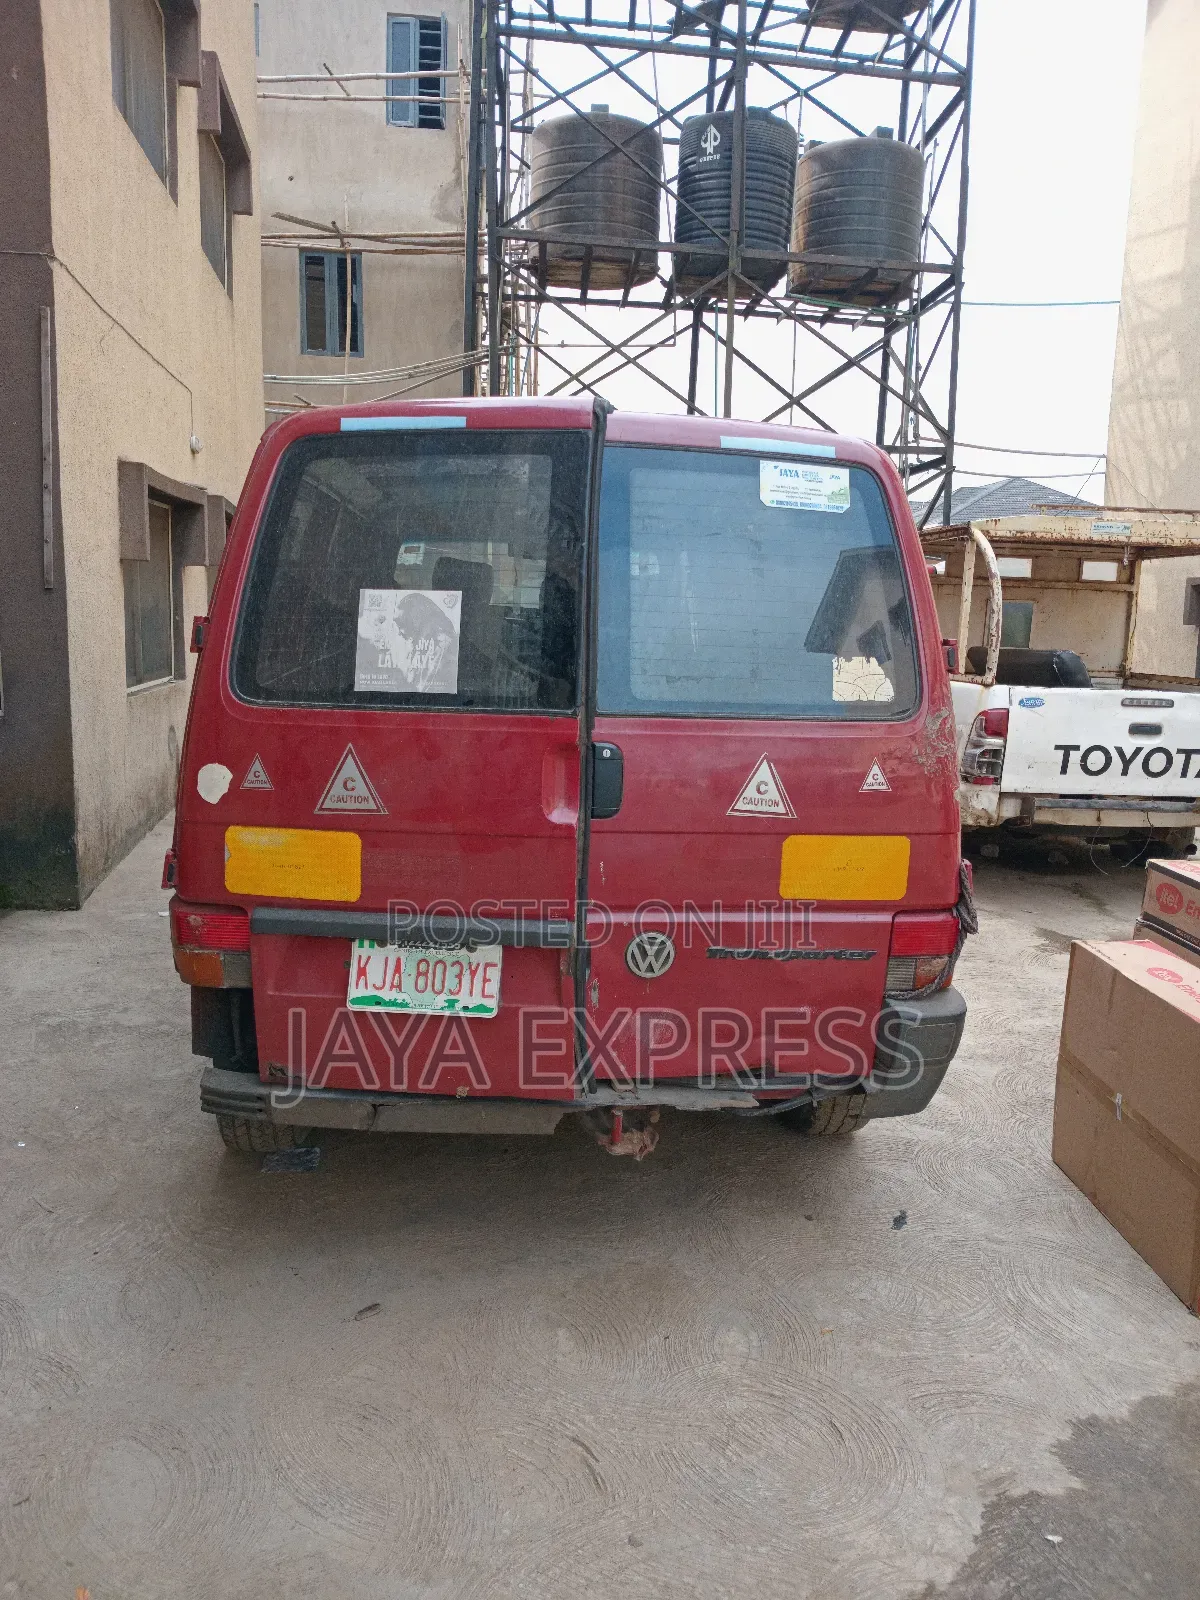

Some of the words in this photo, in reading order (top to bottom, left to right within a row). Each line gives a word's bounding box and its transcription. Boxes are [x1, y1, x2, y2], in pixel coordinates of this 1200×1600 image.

[1053, 744, 1200, 779] TOYOT
[253, 770, 261, 778] C
[871, 773, 879, 781] C
[342, 776, 356, 792] C
[755, 780, 769, 795] C
[330, 794, 370, 804] CAUTION
[742, 796, 780, 808] CAUTION
[355, 955, 403, 992] KJA
[414, 958, 499, 999] 803YE
